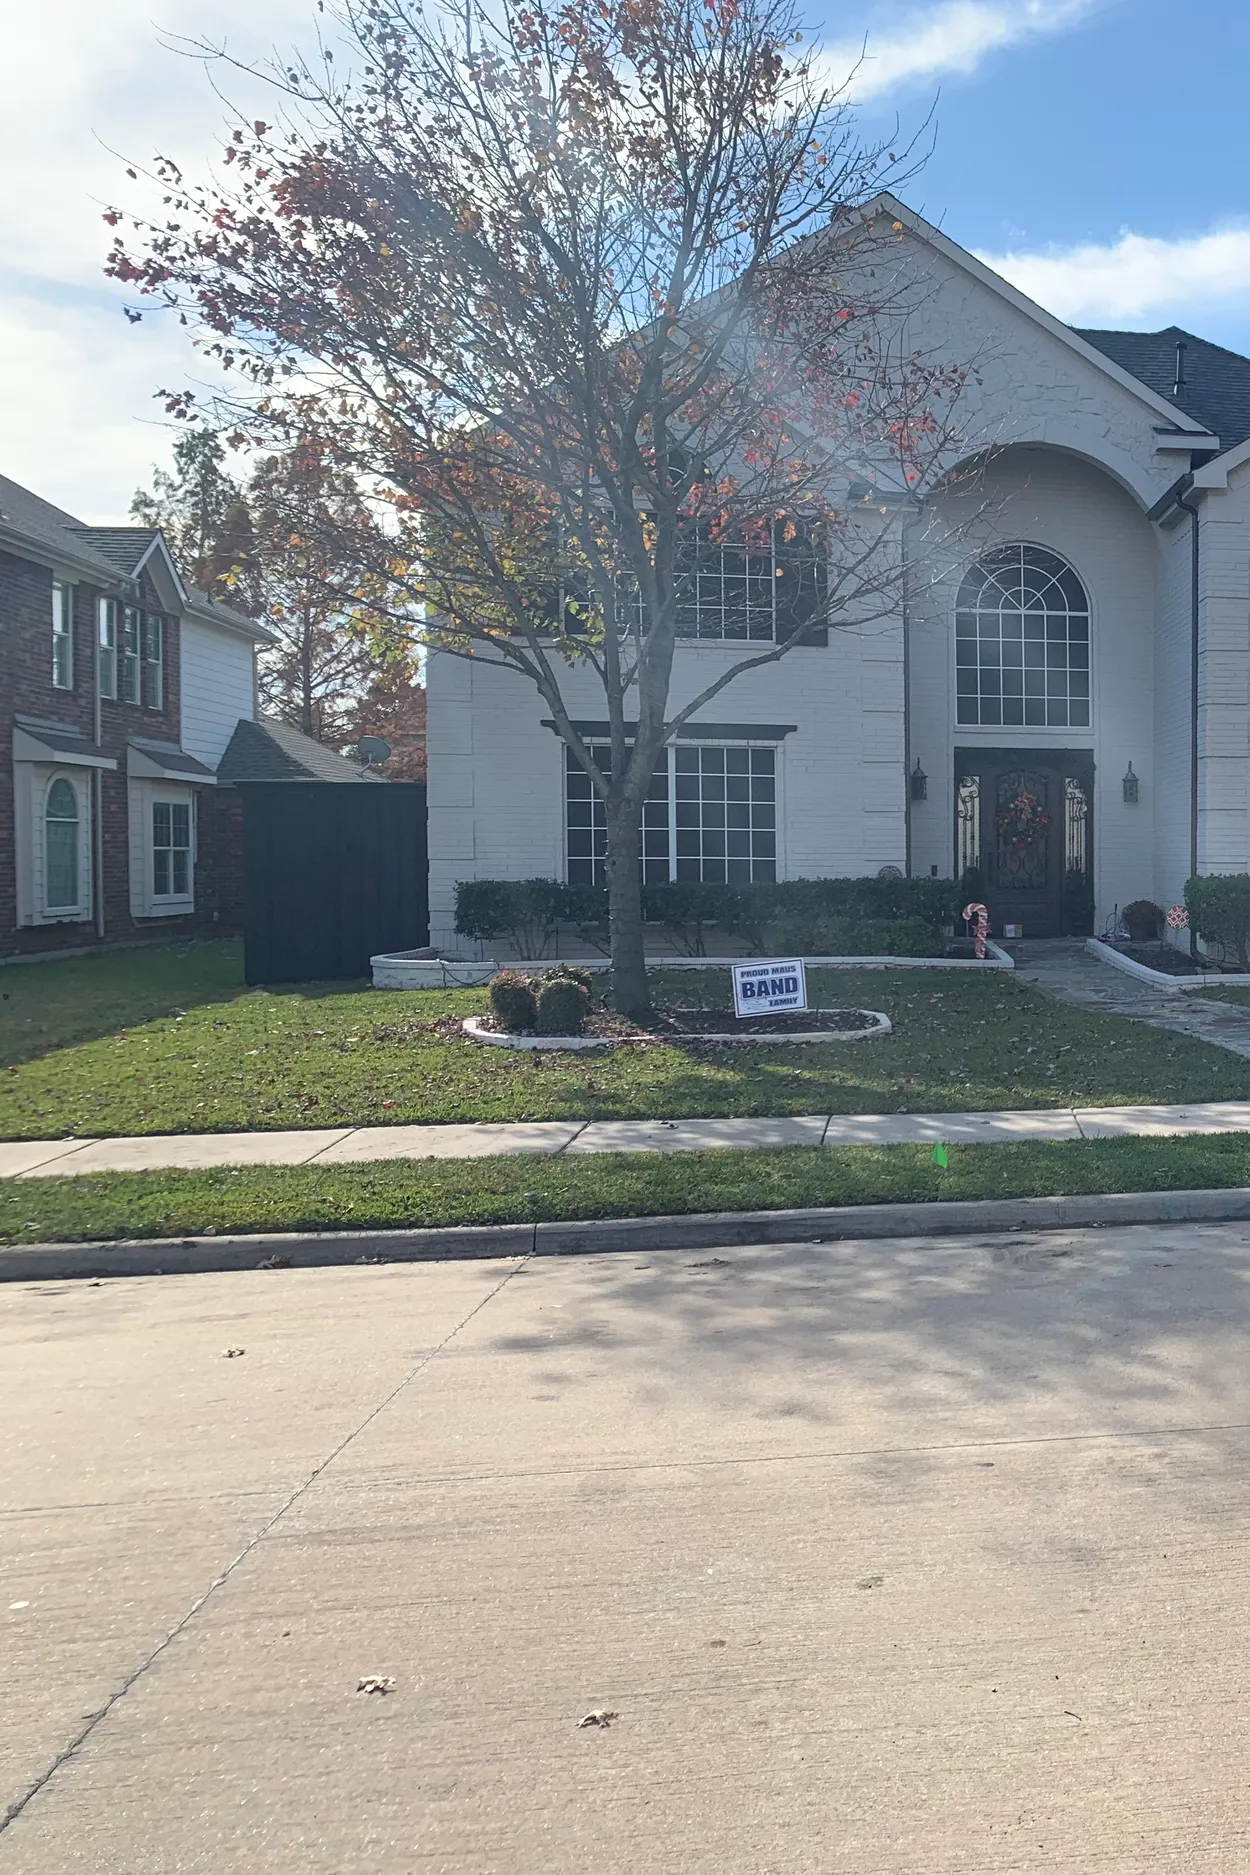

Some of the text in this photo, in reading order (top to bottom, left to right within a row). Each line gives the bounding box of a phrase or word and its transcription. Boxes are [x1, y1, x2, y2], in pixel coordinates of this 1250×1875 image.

[740, 968, 769, 978] PROUD
[741, 977, 798, 998] BAND
[768, 996, 798, 1007] FAMILY
